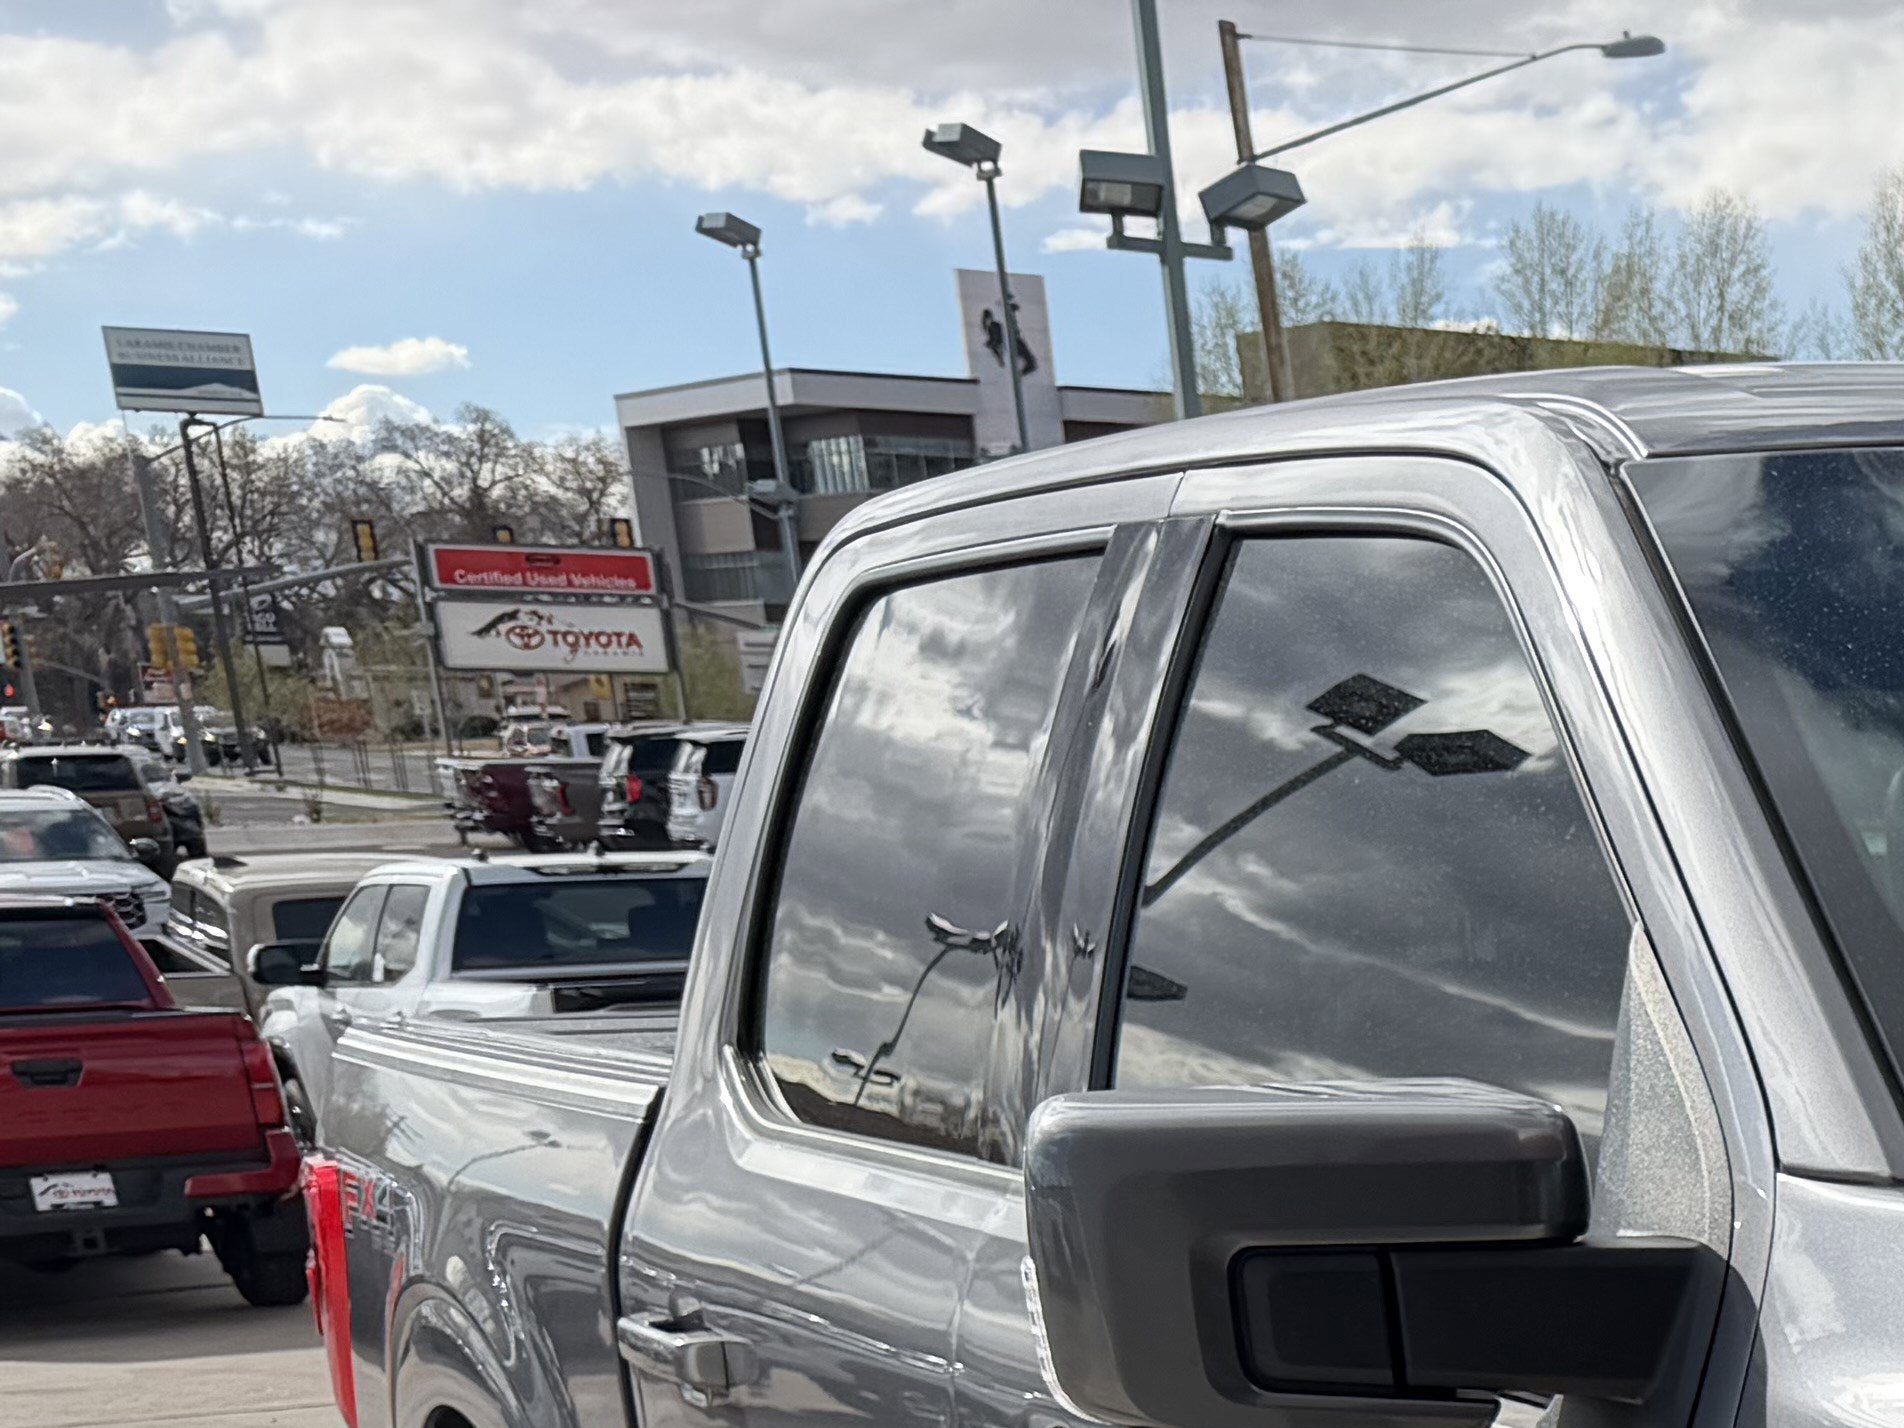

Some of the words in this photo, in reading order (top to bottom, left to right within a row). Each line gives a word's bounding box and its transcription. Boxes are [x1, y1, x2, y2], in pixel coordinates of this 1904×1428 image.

[453, 567, 523, 586] Certified
[524, 570, 568, 588] Used
[571, 572, 637, 591] Vehicles
[546, 629, 644, 652] TOYOTA
